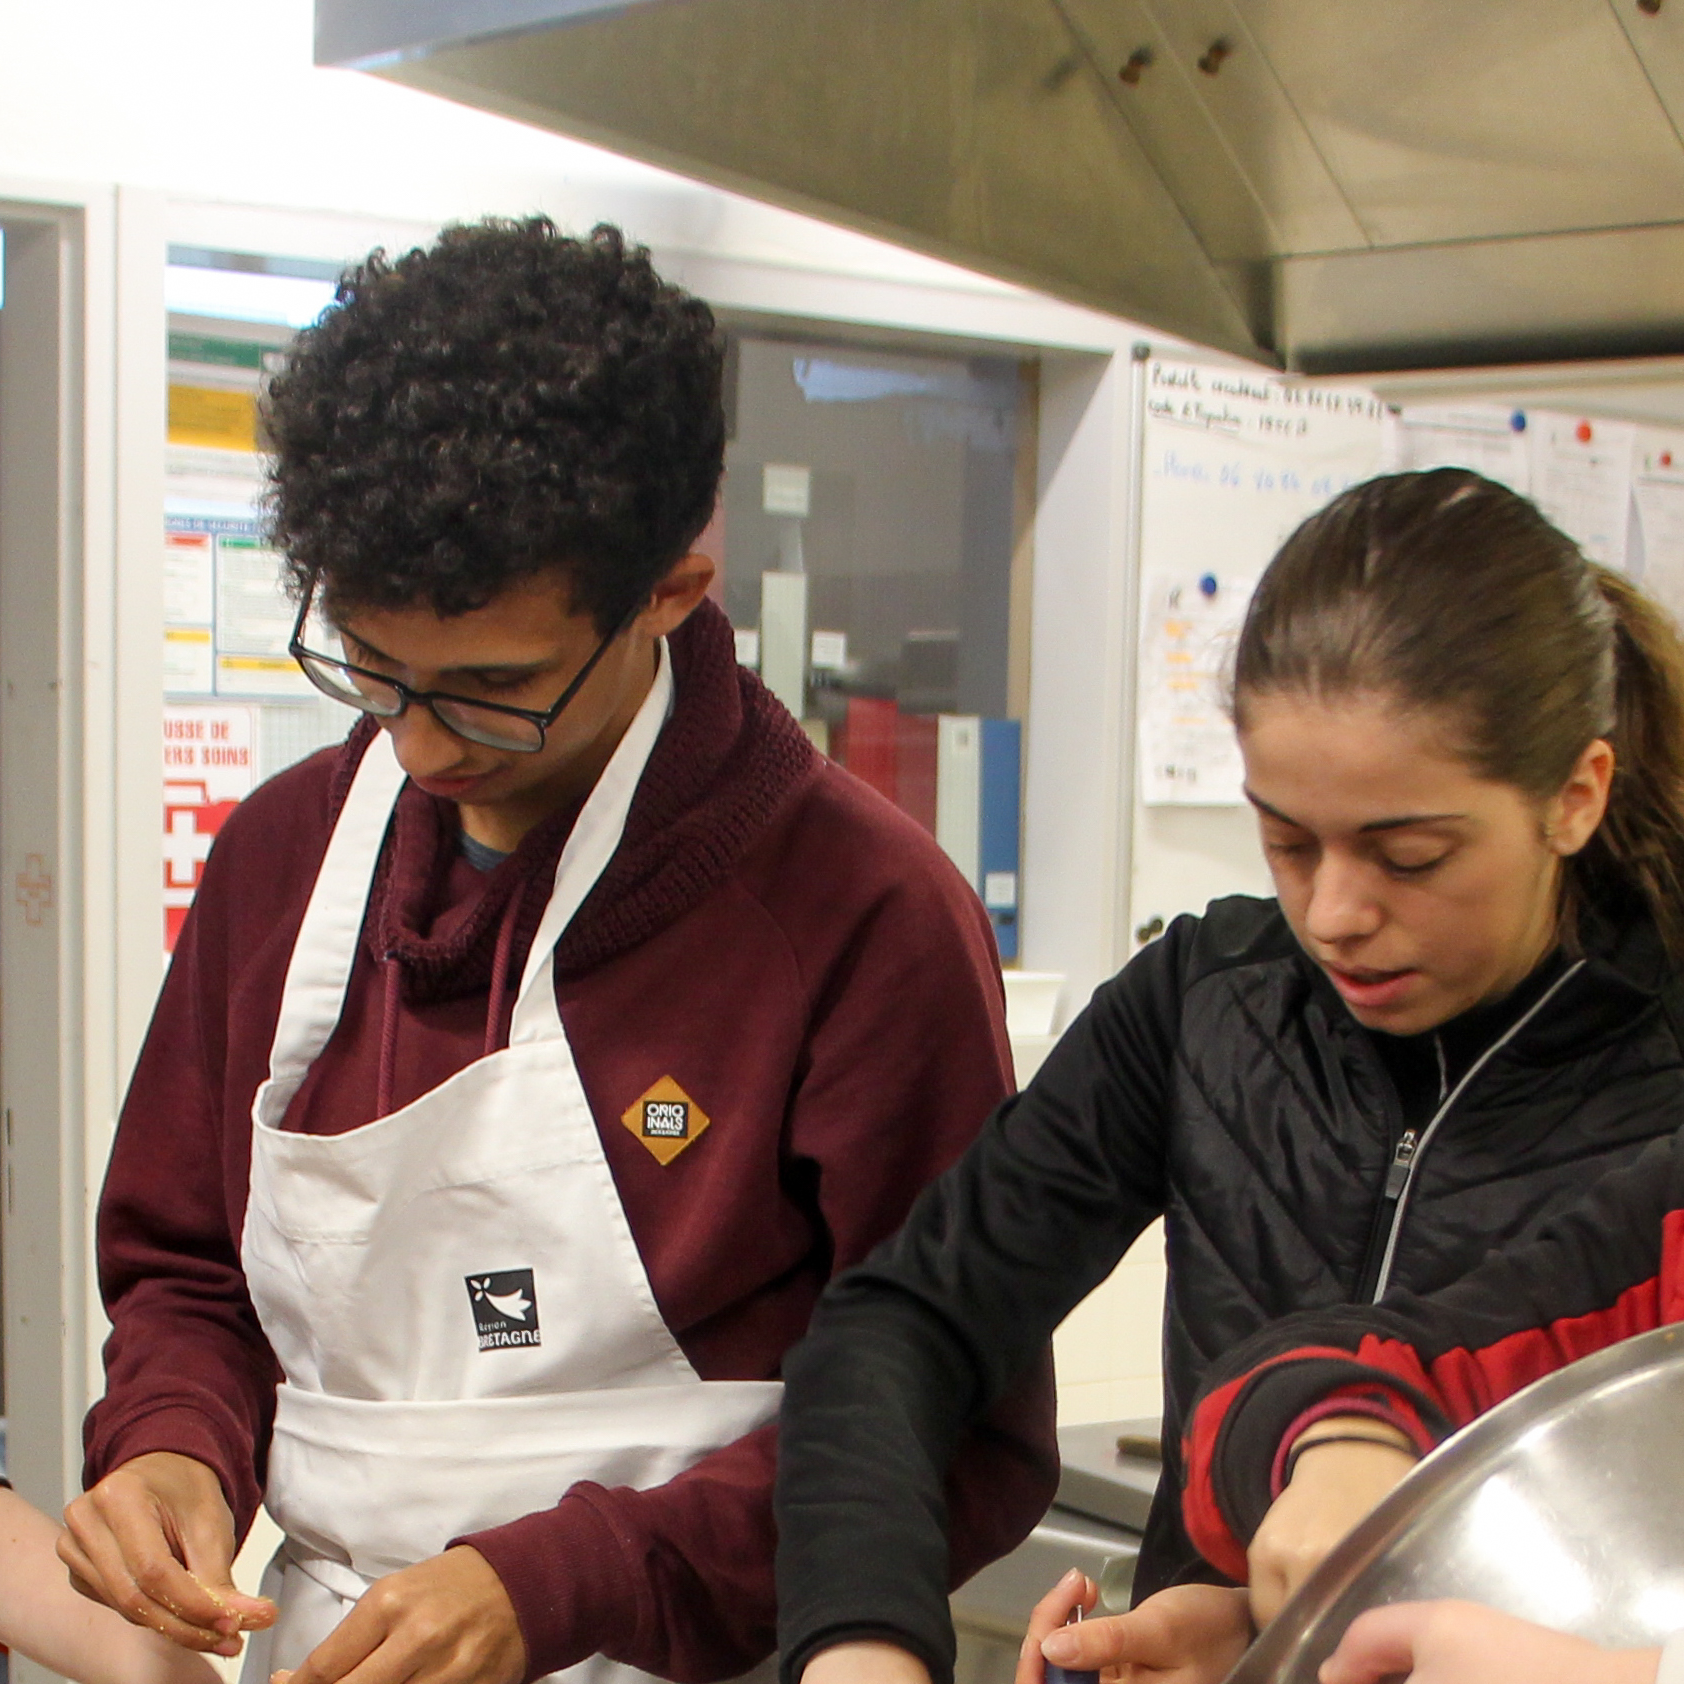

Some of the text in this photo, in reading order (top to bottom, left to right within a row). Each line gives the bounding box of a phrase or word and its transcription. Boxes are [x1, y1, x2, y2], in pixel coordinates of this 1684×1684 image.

[210, 720, 229, 740] DE
[202, 746, 249, 767] SOINS
[479, 1329, 541, 1349] BRETAGNE
